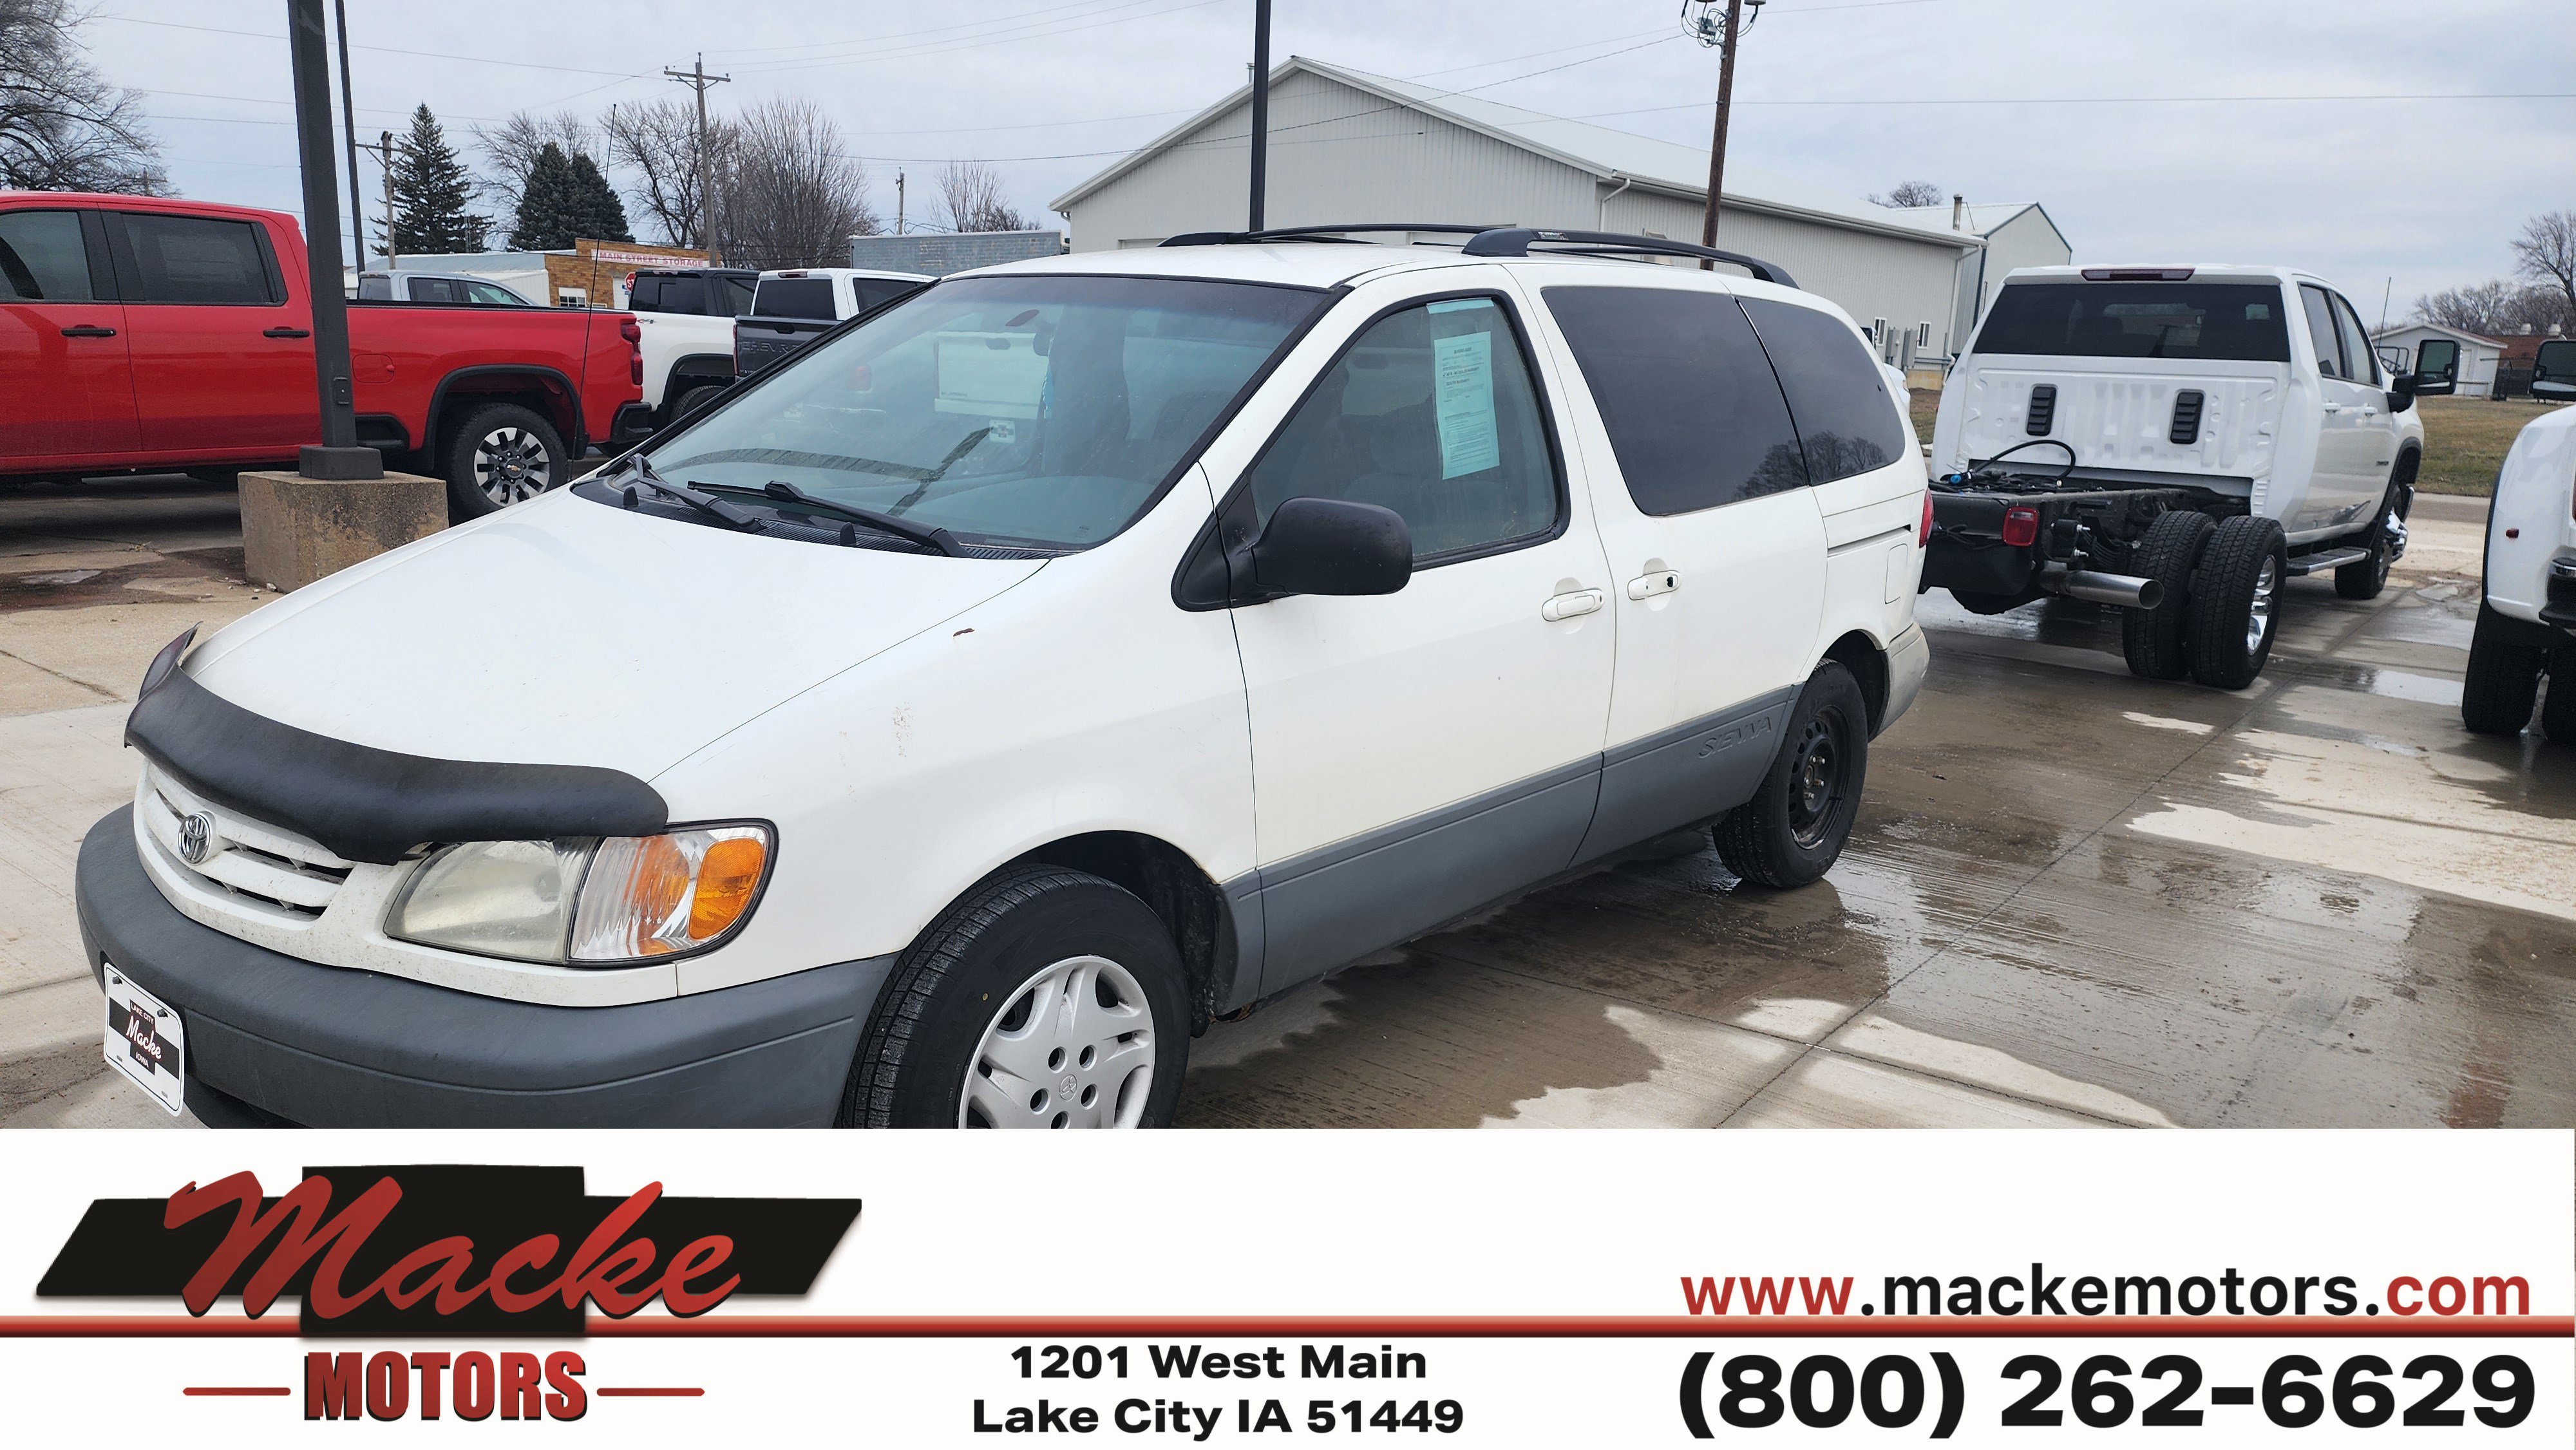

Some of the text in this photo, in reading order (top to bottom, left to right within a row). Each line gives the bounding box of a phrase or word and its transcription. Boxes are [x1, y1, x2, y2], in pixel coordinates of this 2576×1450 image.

[600, 251, 703, 267] MAIN STREET STORAGE
[627, 279, 635, 288] ST
[131, 1002, 154, 1024] LAKE CITY
[126, 1015, 162, 1059] Macke
[135, 1051, 149, 1068] IOWA
